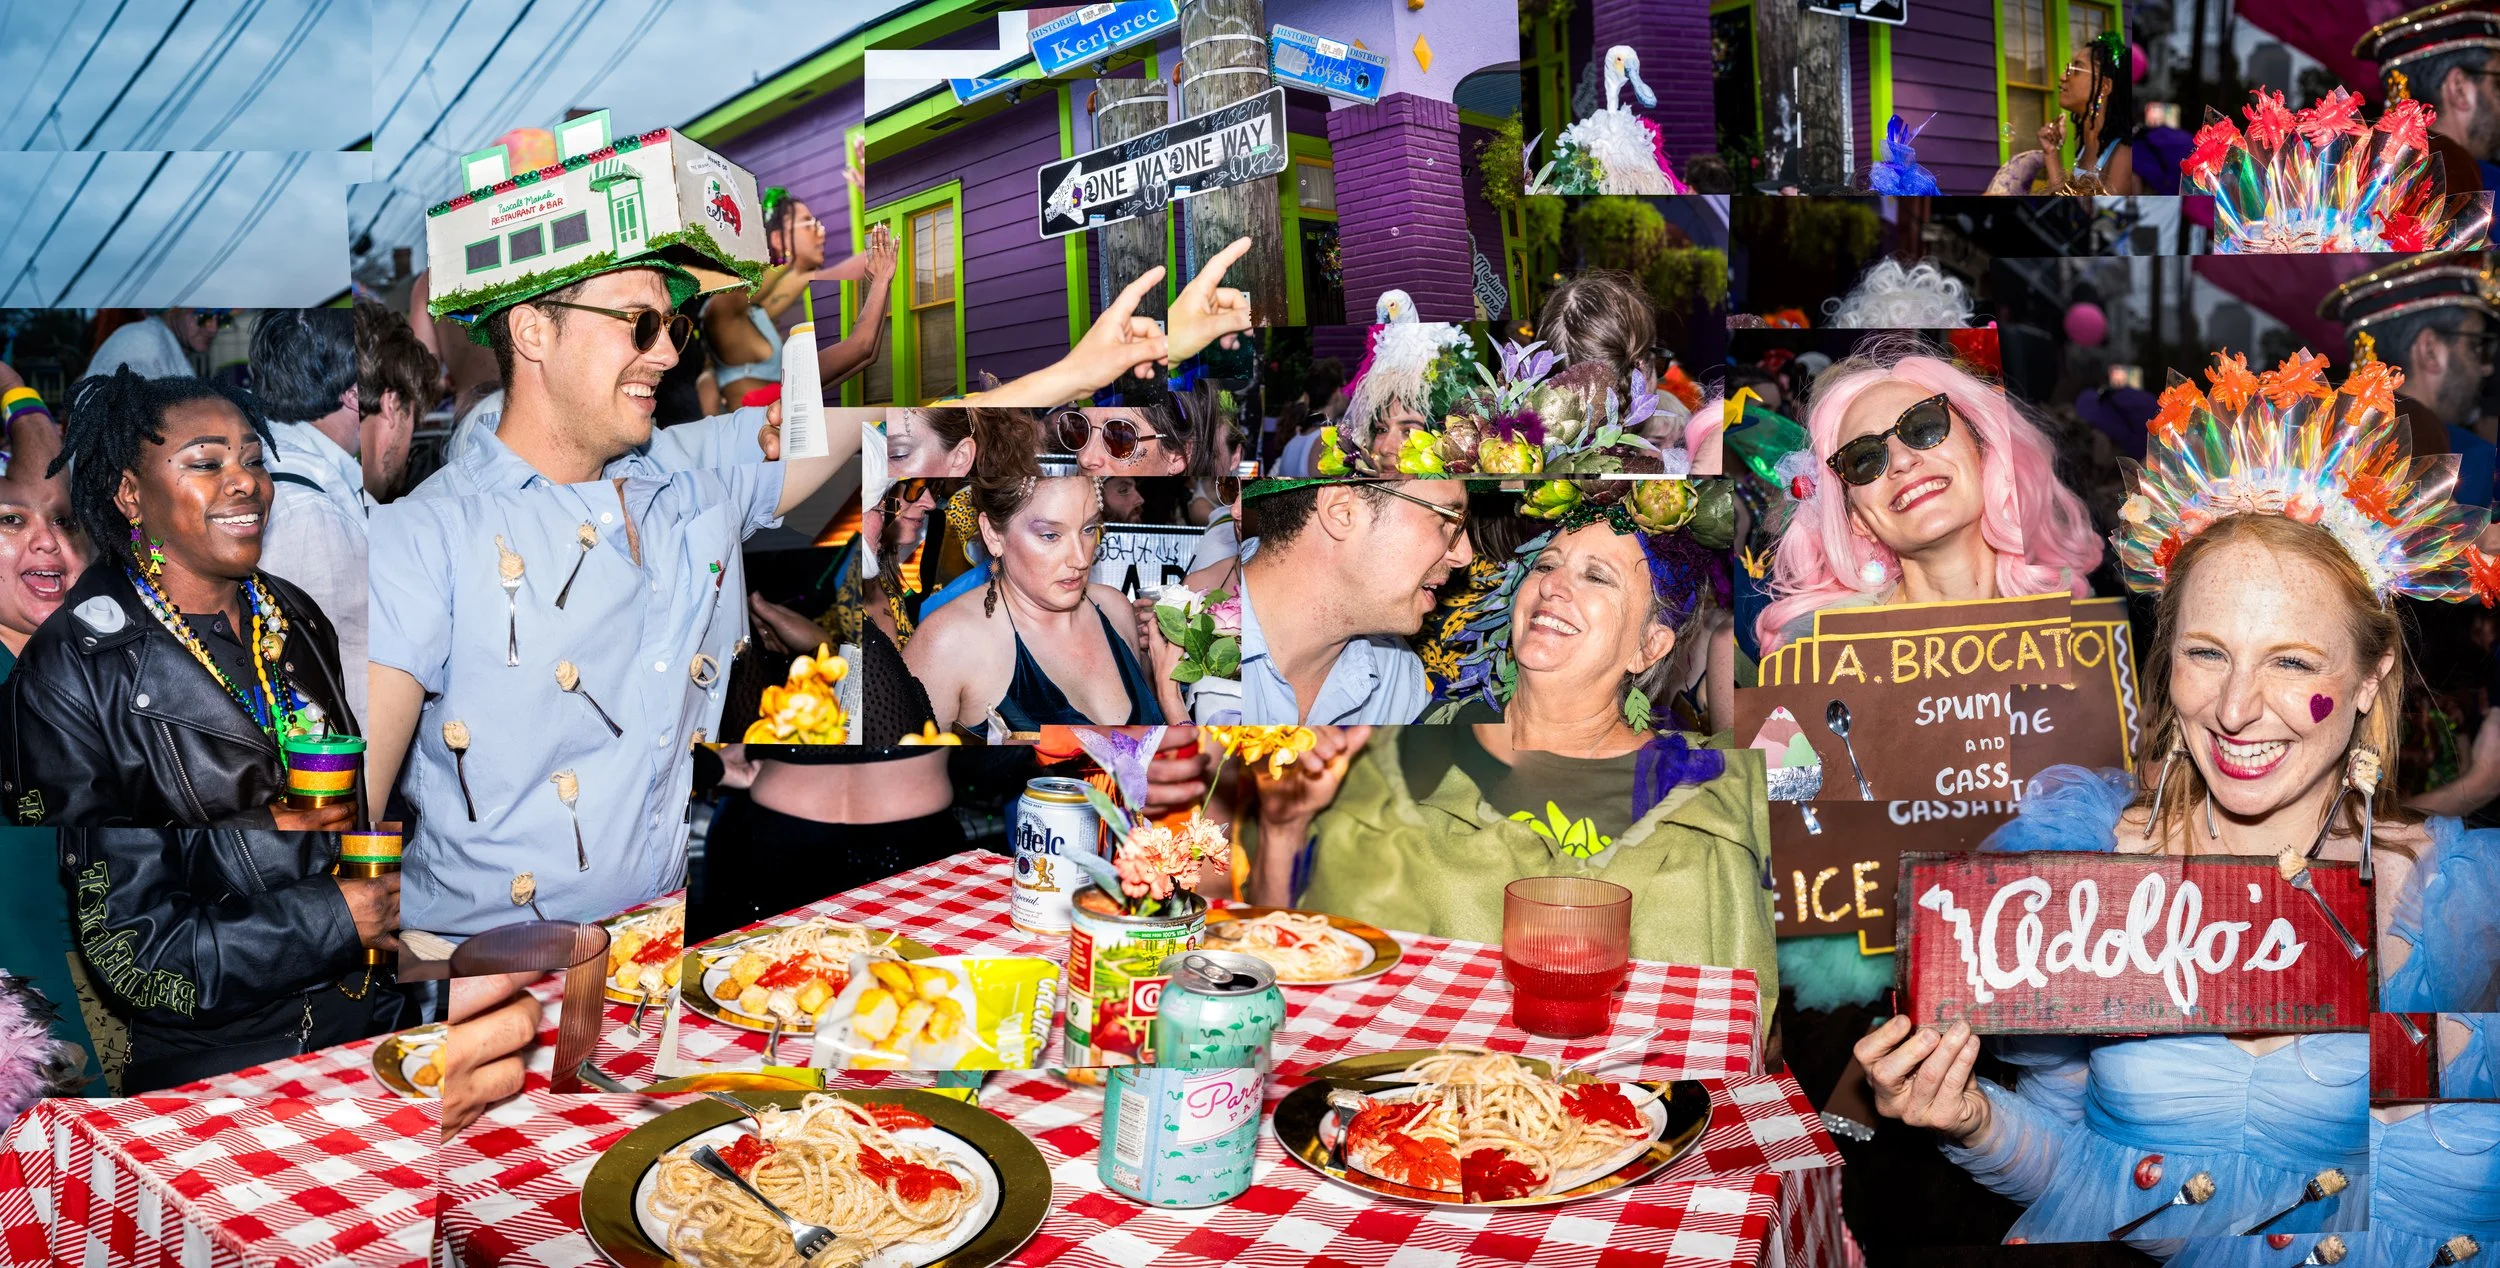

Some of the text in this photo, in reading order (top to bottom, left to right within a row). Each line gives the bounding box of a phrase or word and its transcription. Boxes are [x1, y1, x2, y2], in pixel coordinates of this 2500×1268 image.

[1031, 13, 1077, 39] HISTORIC
[1051, 8, 1161, 64] Kerlerec
[1276, 27, 1316, 45] HISTORIC
[1350, 47, 1386, 65] DISTRICT
[1170, 141, 1213, 175] ONE
[1221, 119, 1266, 161] WAY
[1083, 164, 1128, 203] ONE
[491, 197, 564, 226] RESTAURANT & BAR
[1475, 255, 1506, 302] Medium
[1475, 282, 1501, 313] Rare
[1792, 861, 1884, 923] ICE
